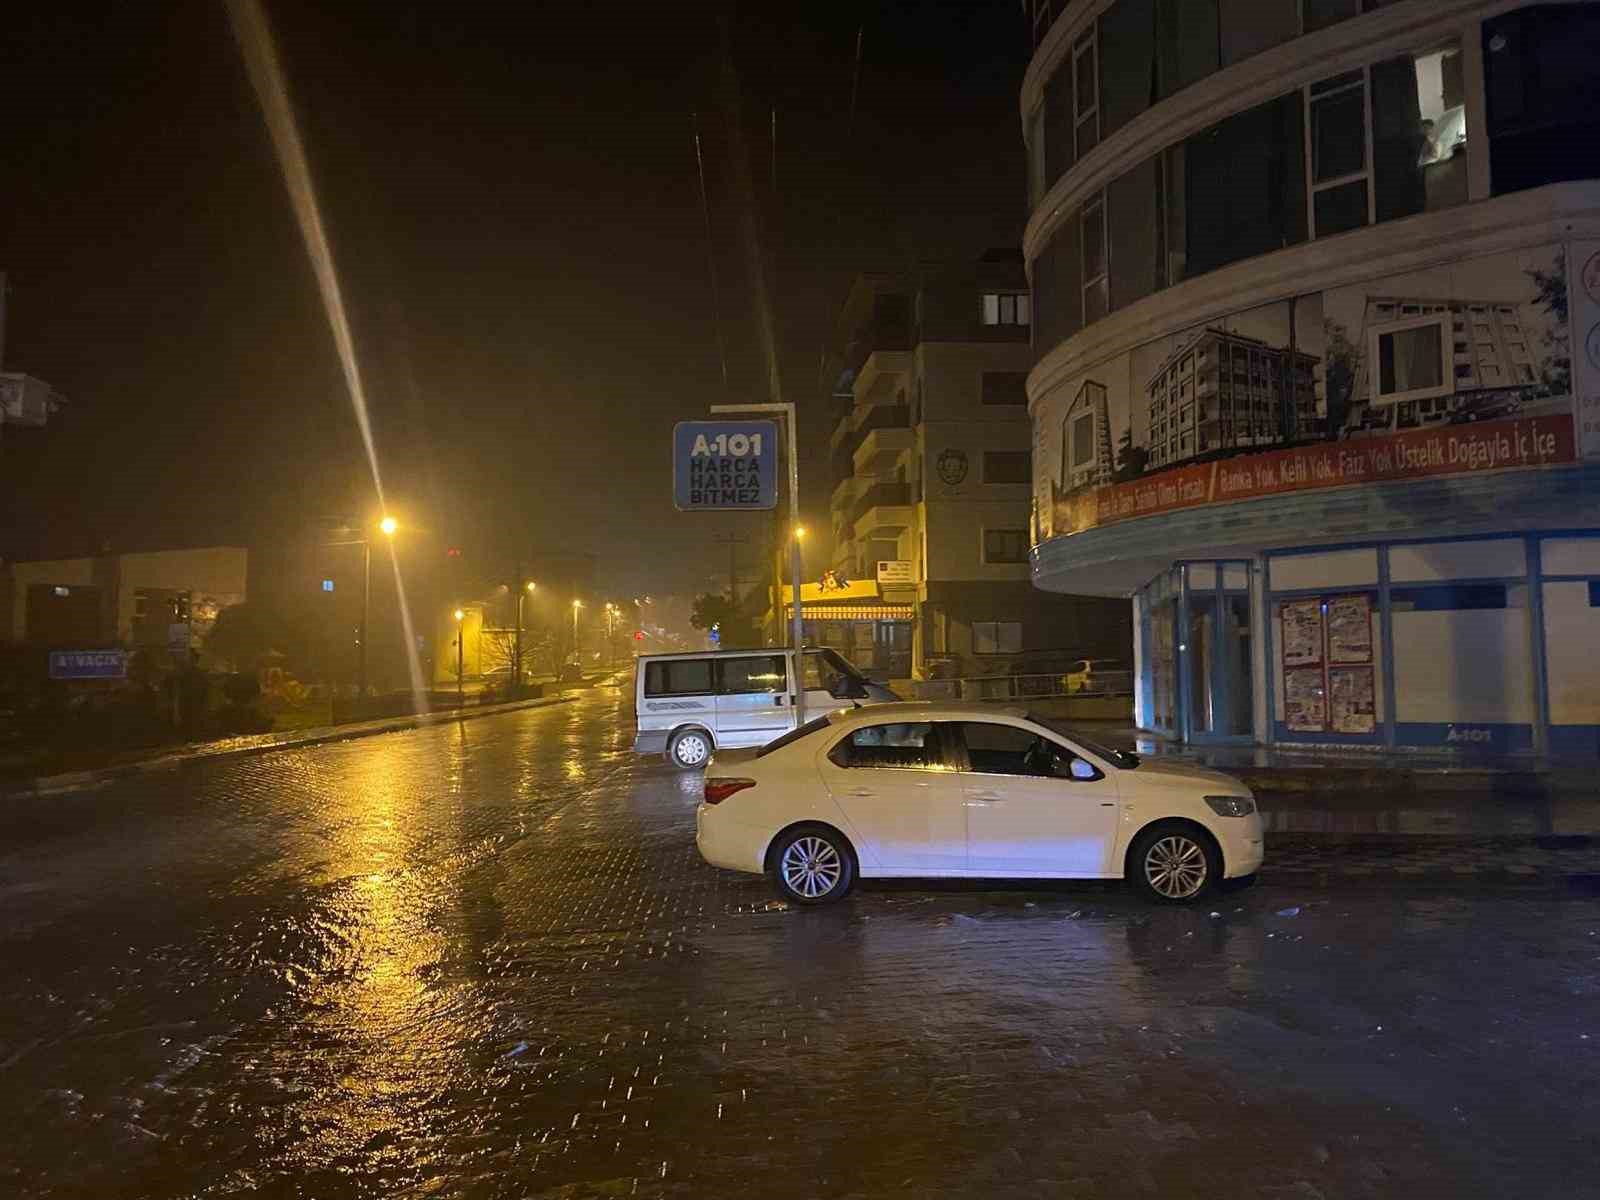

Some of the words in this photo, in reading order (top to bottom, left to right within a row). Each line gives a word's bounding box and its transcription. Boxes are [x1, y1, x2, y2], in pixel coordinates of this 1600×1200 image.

[1339, 450, 1366, 476] Faiz
[1368, 444, 1393, 472] Yok
[1394, 435, 1445, 466] Üstelik
[1448, 431, 1511, 470] Doğayla
[1513, 421, 1529, 460] İç
[1531, 420, 1556, 460] İçe
[690, 458, 761, 473] HARCA
[690, 474, 761, 488] HARCA
